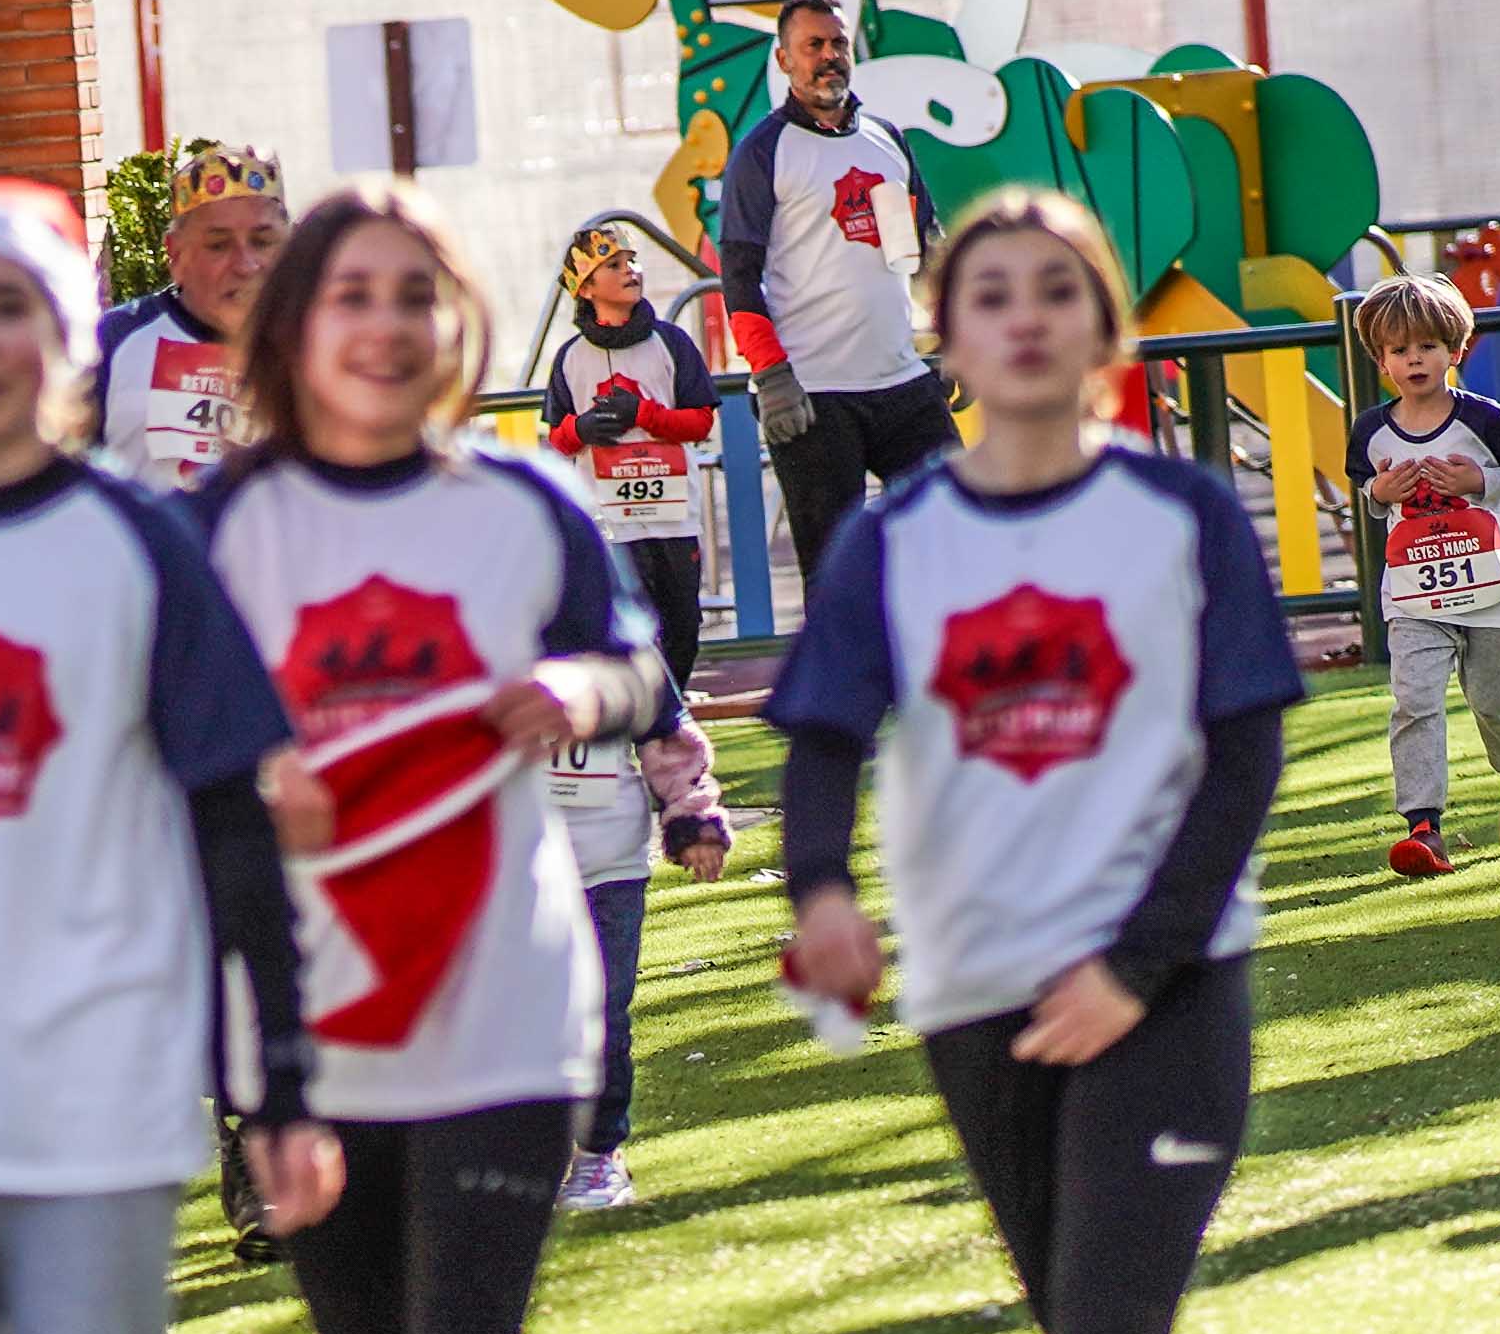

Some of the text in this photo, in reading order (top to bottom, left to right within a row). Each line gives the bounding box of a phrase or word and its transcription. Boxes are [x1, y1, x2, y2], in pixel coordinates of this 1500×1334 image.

[616, 480, 664, 500] 493
[1407, 537, 1480, 562] REYES MAGOS
[1418, 558, 1474, 590] 351
